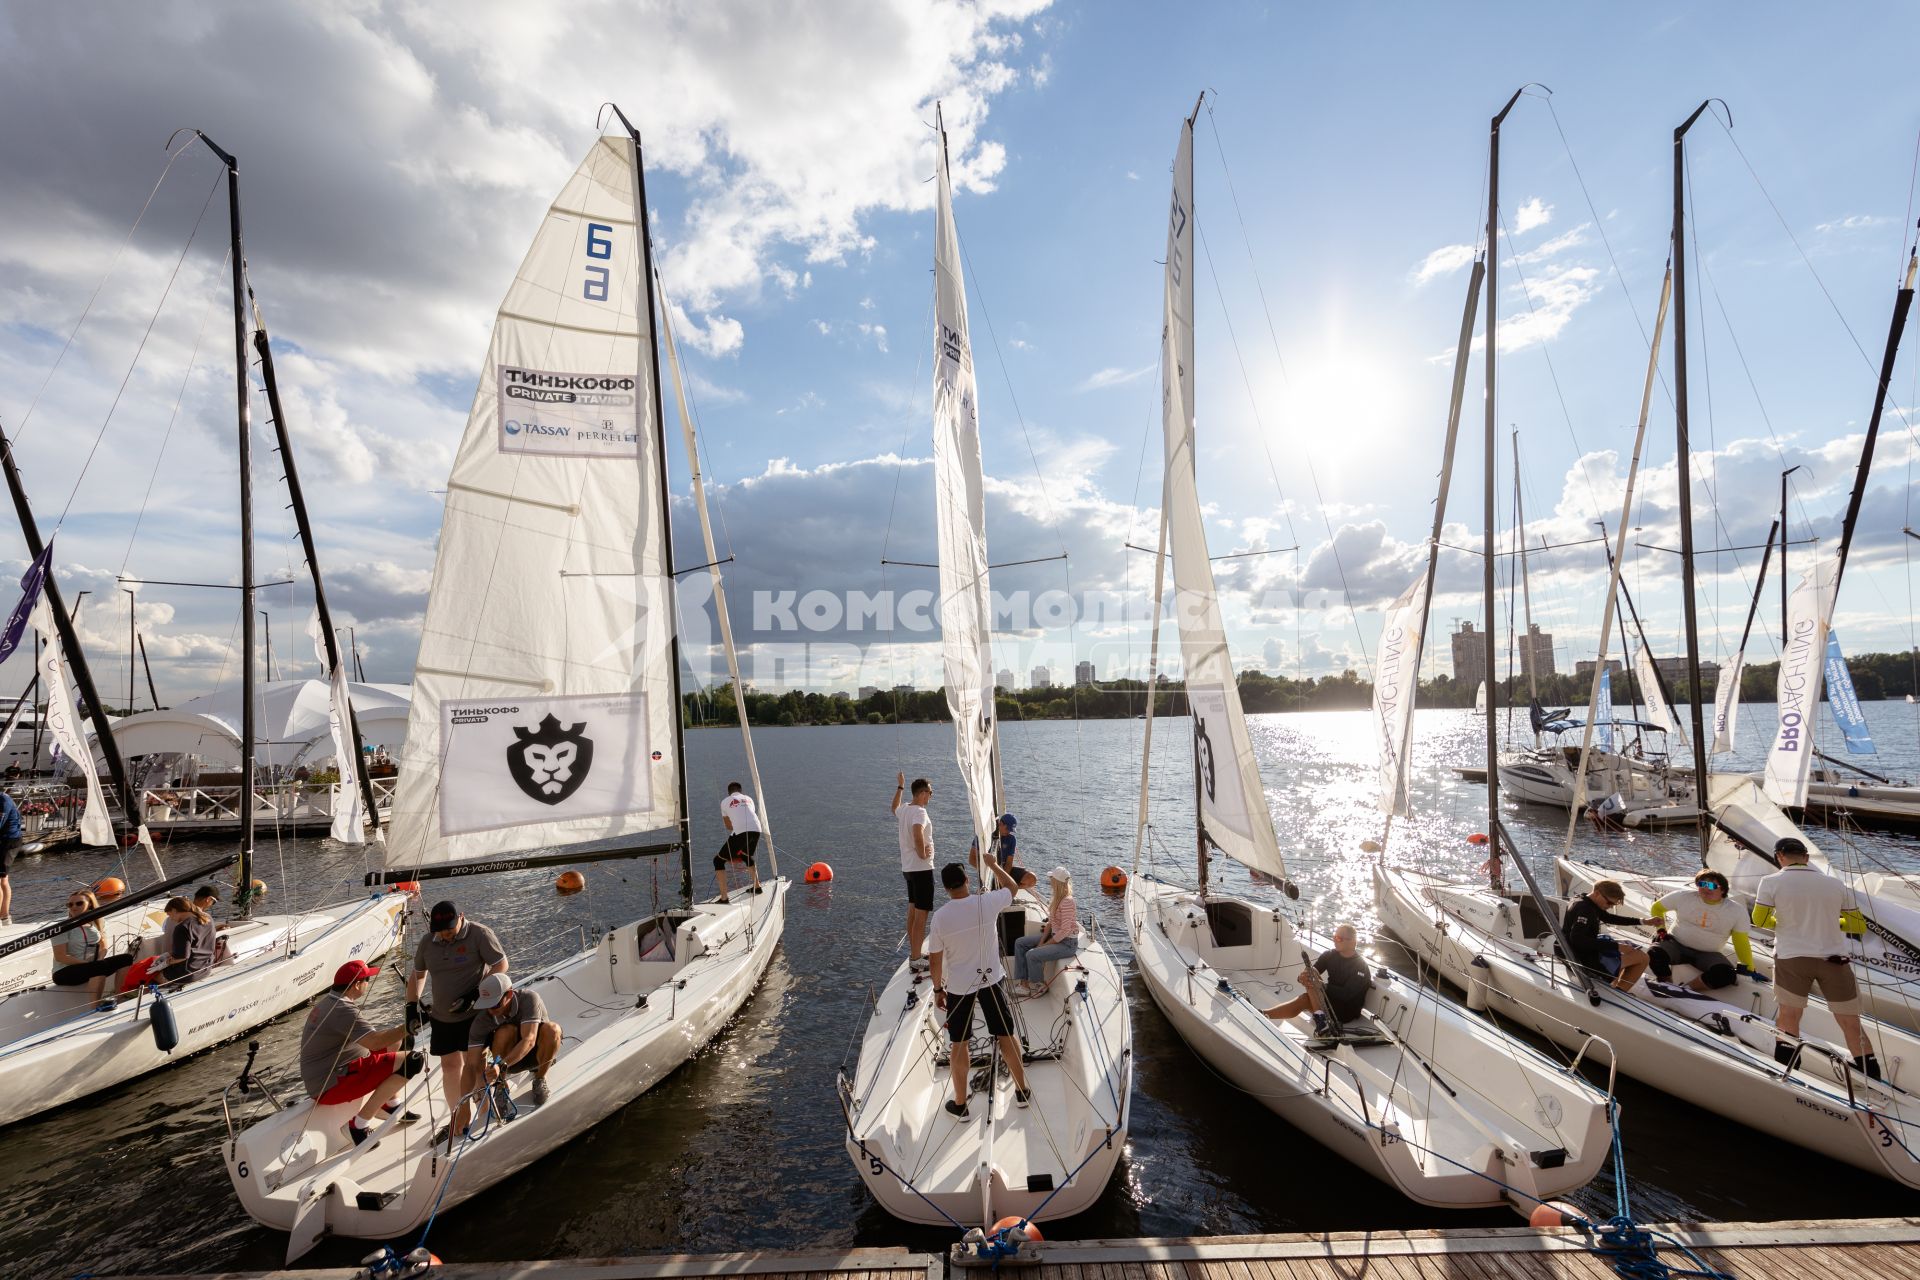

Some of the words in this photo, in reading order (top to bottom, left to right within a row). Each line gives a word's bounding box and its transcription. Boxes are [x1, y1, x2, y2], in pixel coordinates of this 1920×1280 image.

[587, 223, 613, 260] 6
[505, 369, 635, 391] ТИНЬКОФФ
[511, 387, 573, 402] PRIVATE
[522, 423, 571, 436] TASSAY
[577, 431, 639, 443] PERRELET
[450, 706, 520, 717] ТИНЬКОФФ
[453, 716, 488, 724] PRIVATE
[450, 860, 528, 876] pro-yachting.ru
[609, 954, 618, 965] 6
[1796, 1097, 1820, 1112] RUS
[1878, 1129, 1893, 1148] 3
[238, 1160, 249, 1178] 6
[869, 1157, 884, 1176] 5
